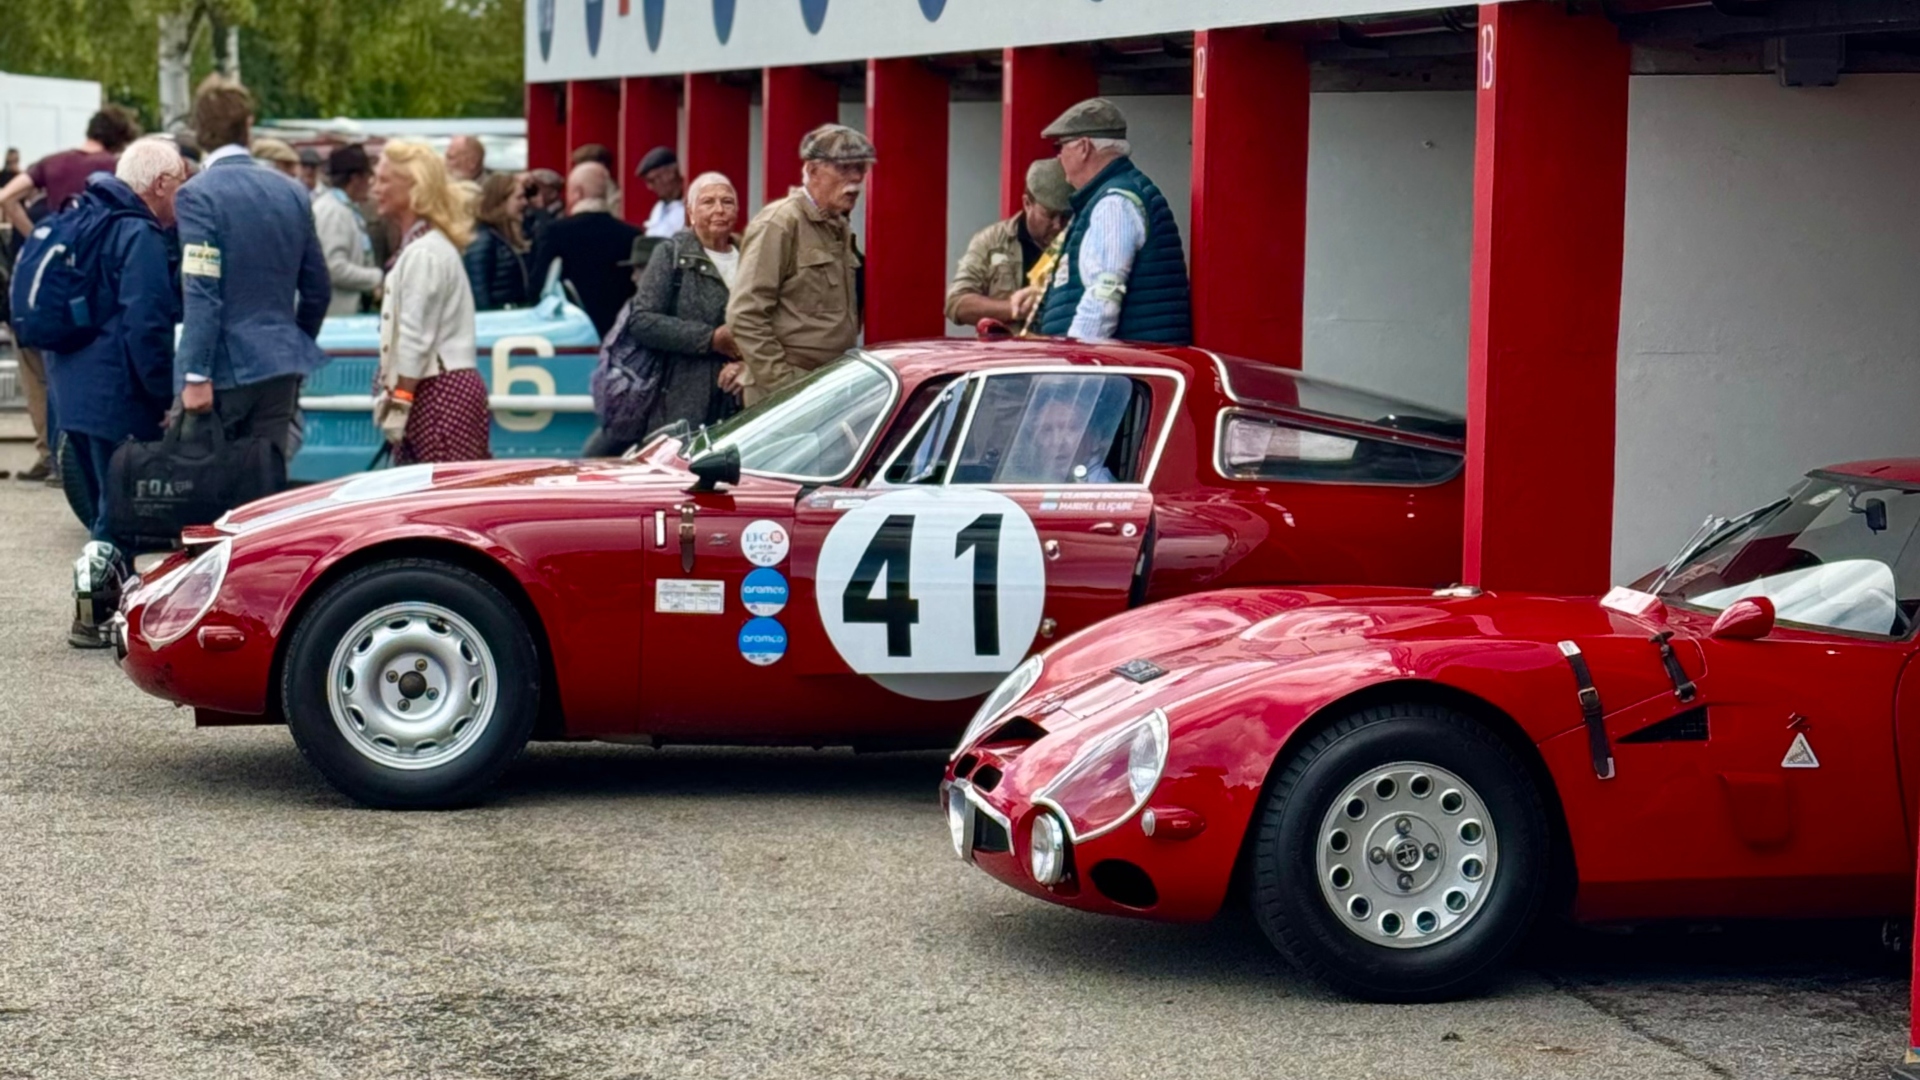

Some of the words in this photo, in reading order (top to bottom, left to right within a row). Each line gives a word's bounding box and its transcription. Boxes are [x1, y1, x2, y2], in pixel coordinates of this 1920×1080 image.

[492, 334, 556, 432] 6
[743, 586, 786, 594] aramco
[842, 513, 1004, 657] 41
[742, 635, 784, 643] aramco
